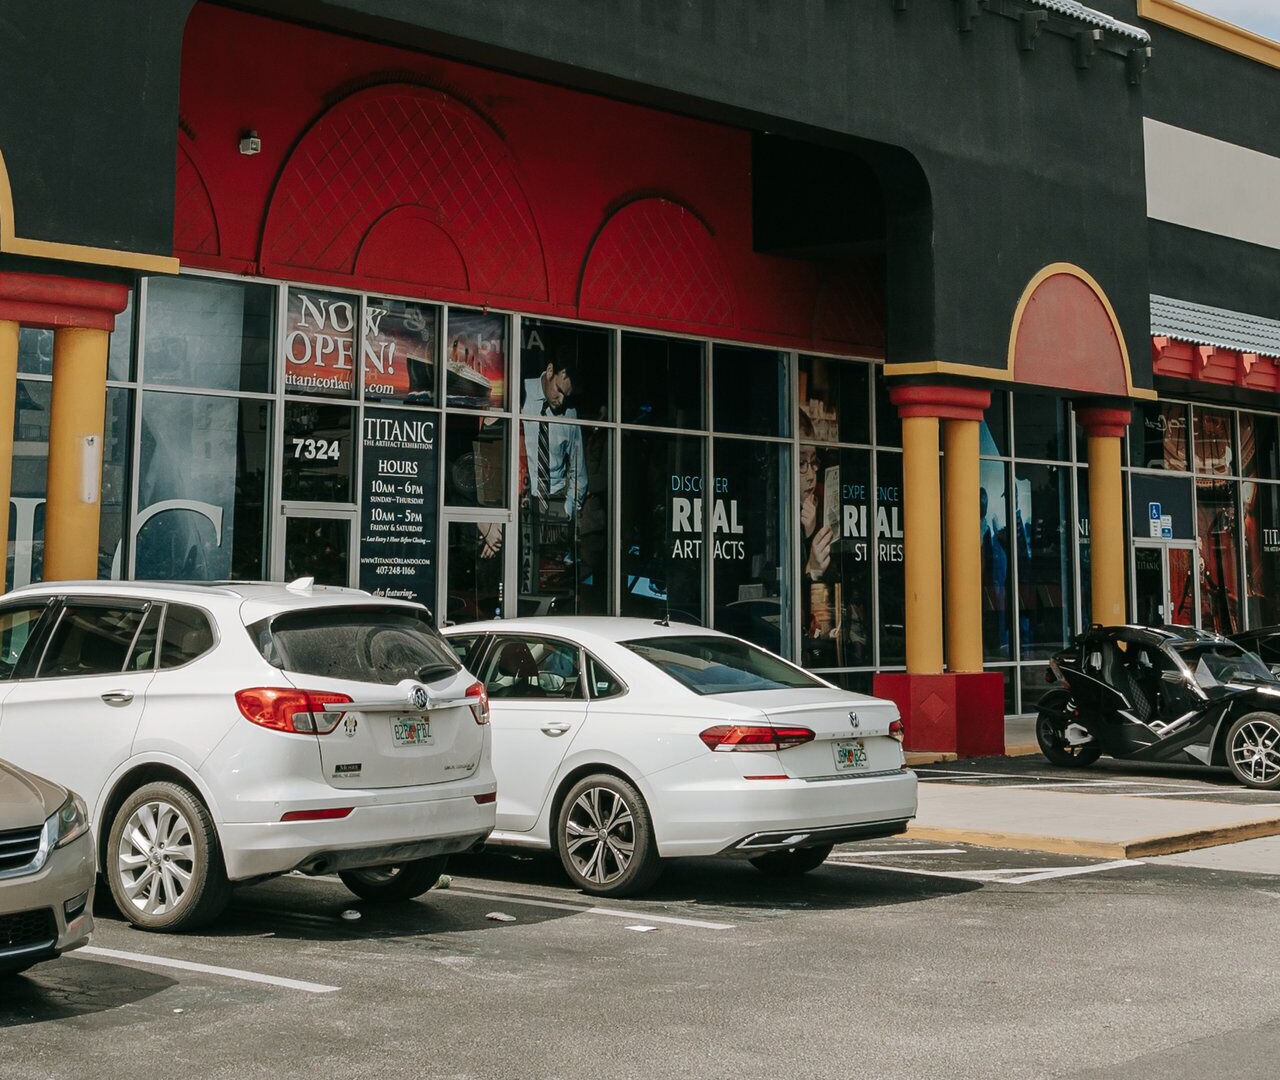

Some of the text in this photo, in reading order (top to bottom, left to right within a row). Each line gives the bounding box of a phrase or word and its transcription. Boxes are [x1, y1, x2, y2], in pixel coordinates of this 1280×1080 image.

[286, 330, 396, 375] OPEN!
[285, 370, 394, 395] titanicorlan.com
[364, 418, 434, 443] TITANIC
[292, 438, 340, 460] 7324
[364, 439, 433, 450] THE ARTIFACT EXHIBITION
[378, 459, 418, 474] HOURS
[371, 480, 395, 494] 10AM
[404, 481, 423, 495] 6PM
[672, 475, 728, 493] DISCER
[842, 484, 898, 501] EXPENCE
[371, 508, 395, 521] 10AM
[405, 509, 422, 522] 5PM
[370, 523, 389, 531] FRIDAY
[396, 524, 423, 532] SATURDAY
[672, 539, 745, 560] ARTACTS
[855, 543, 903, 562] STRIES
